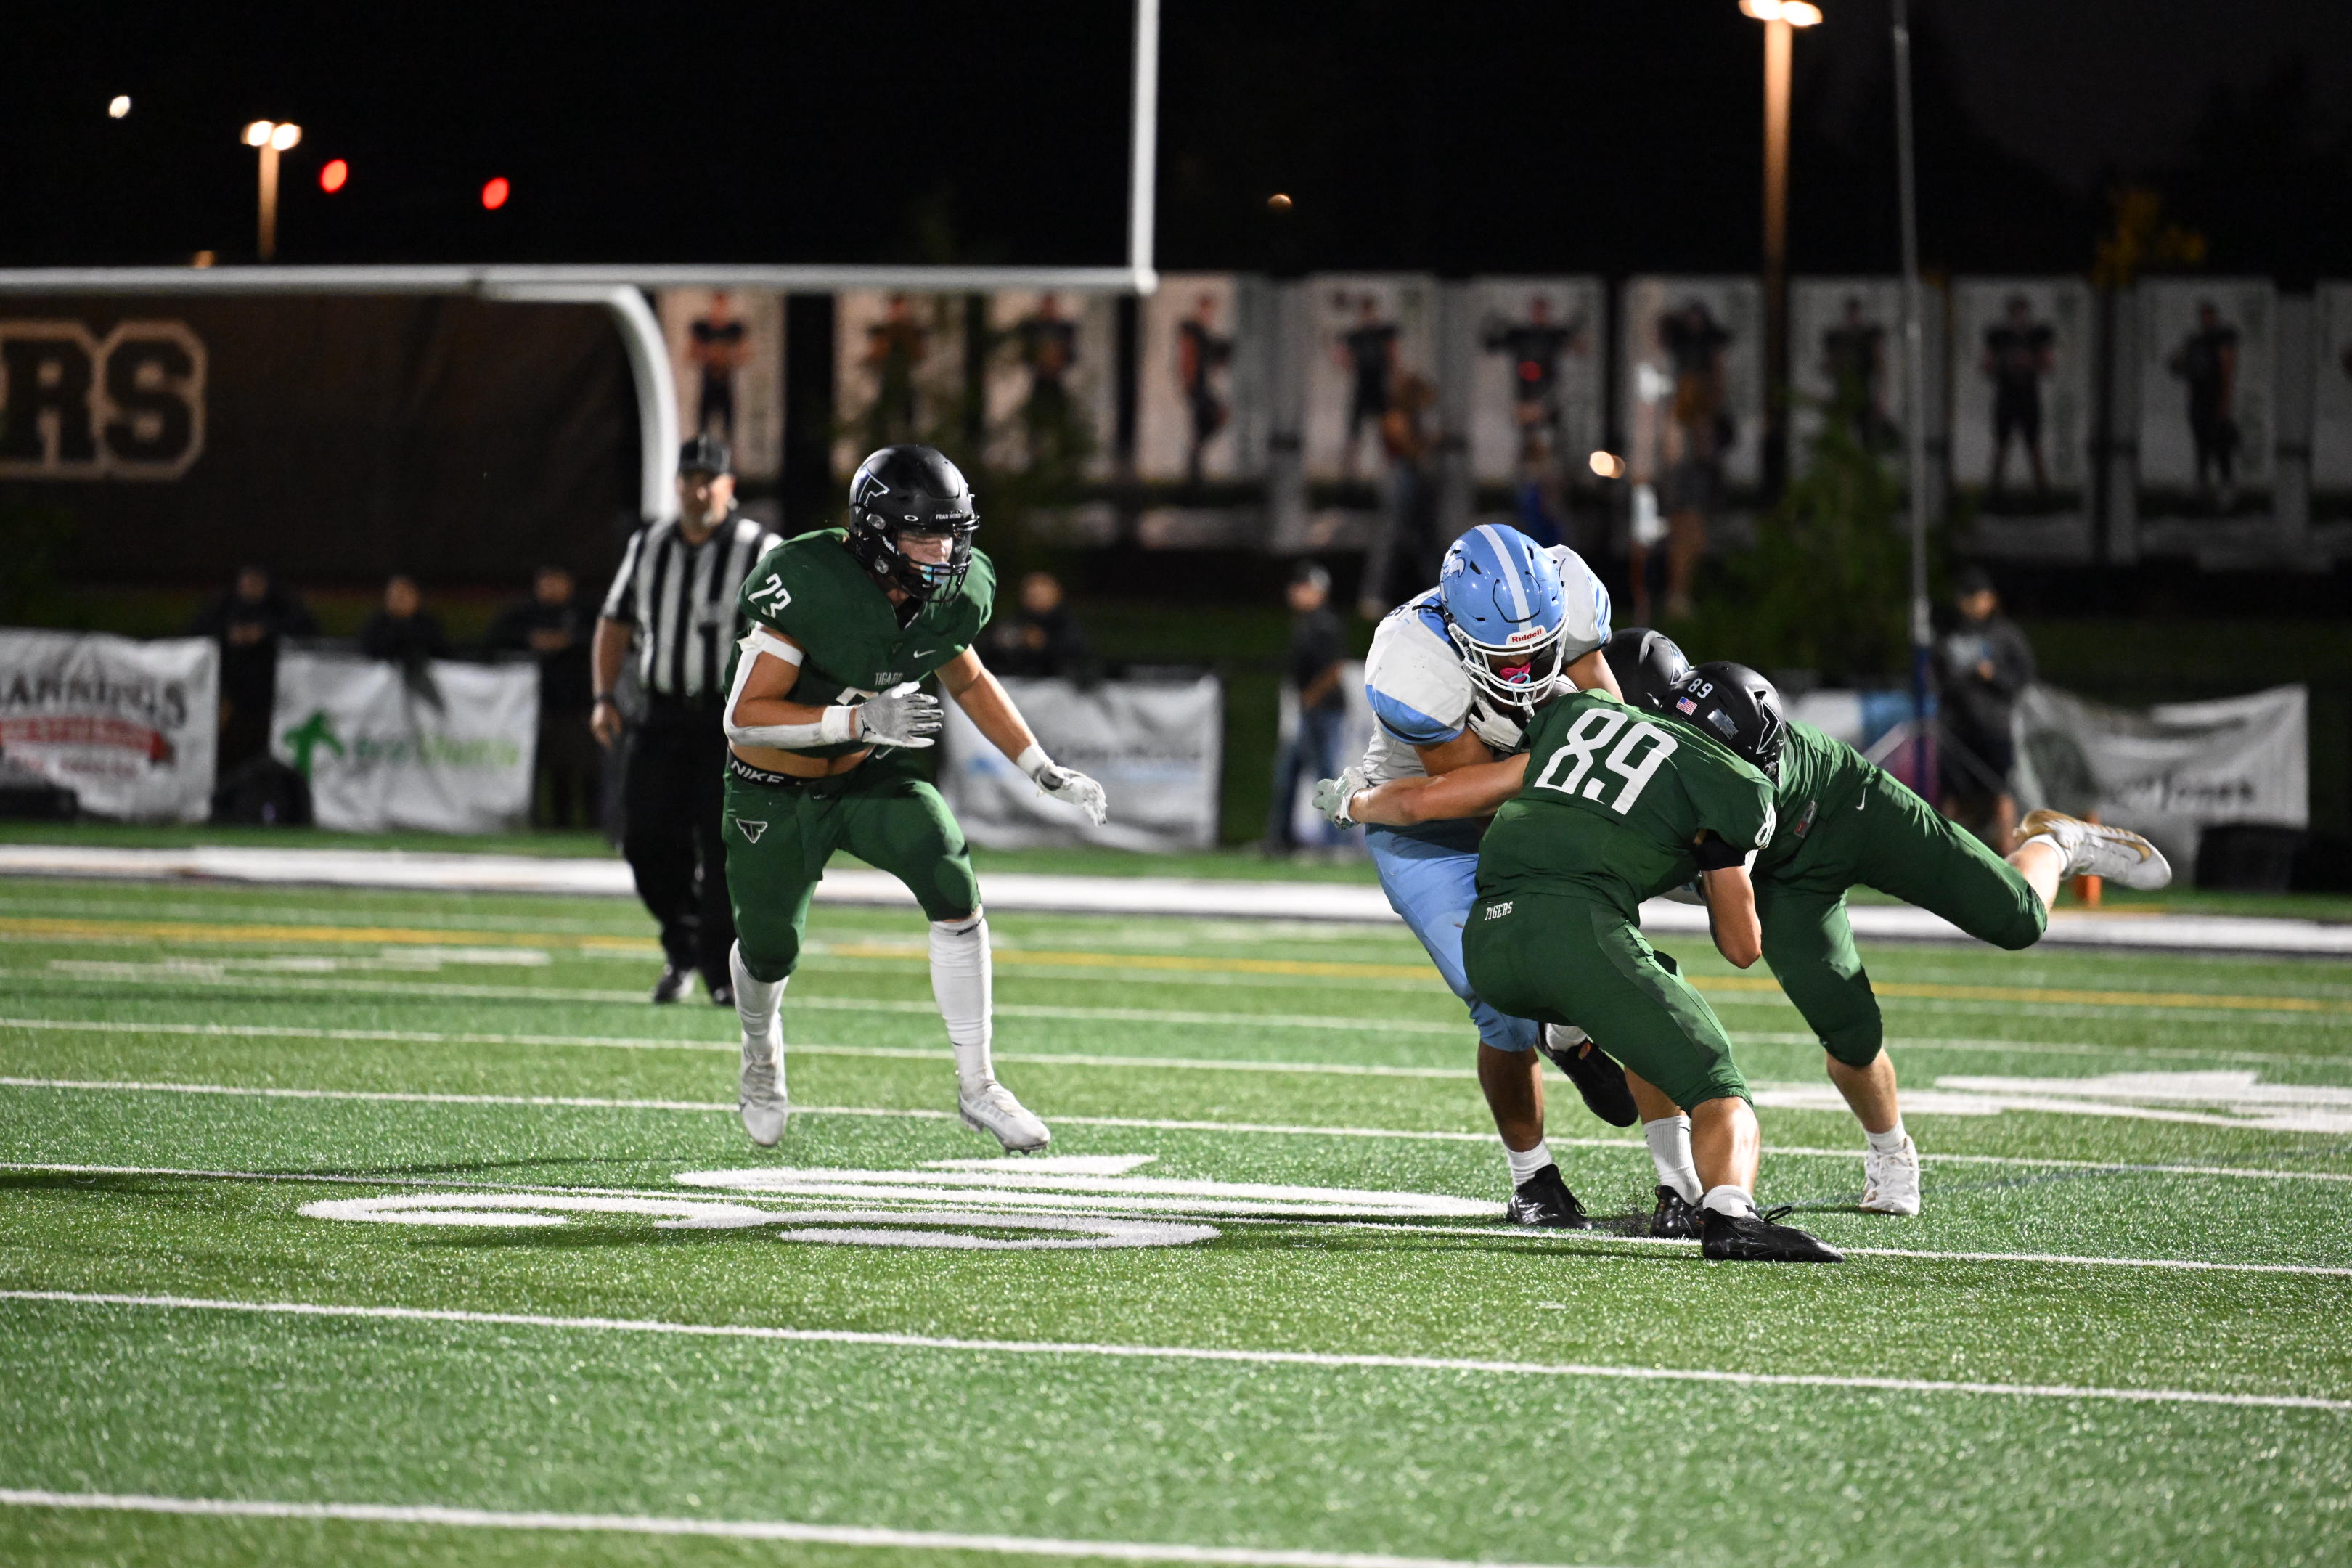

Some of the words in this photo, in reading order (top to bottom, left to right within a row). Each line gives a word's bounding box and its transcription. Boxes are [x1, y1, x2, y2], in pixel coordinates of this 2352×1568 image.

[1511, 629, 1542, 642] Riddell
[1688, 678, 1714, 698] 89
[1534, 708, 1678, 815] 89
[1485, 901, 1514, 920] TIGERS
